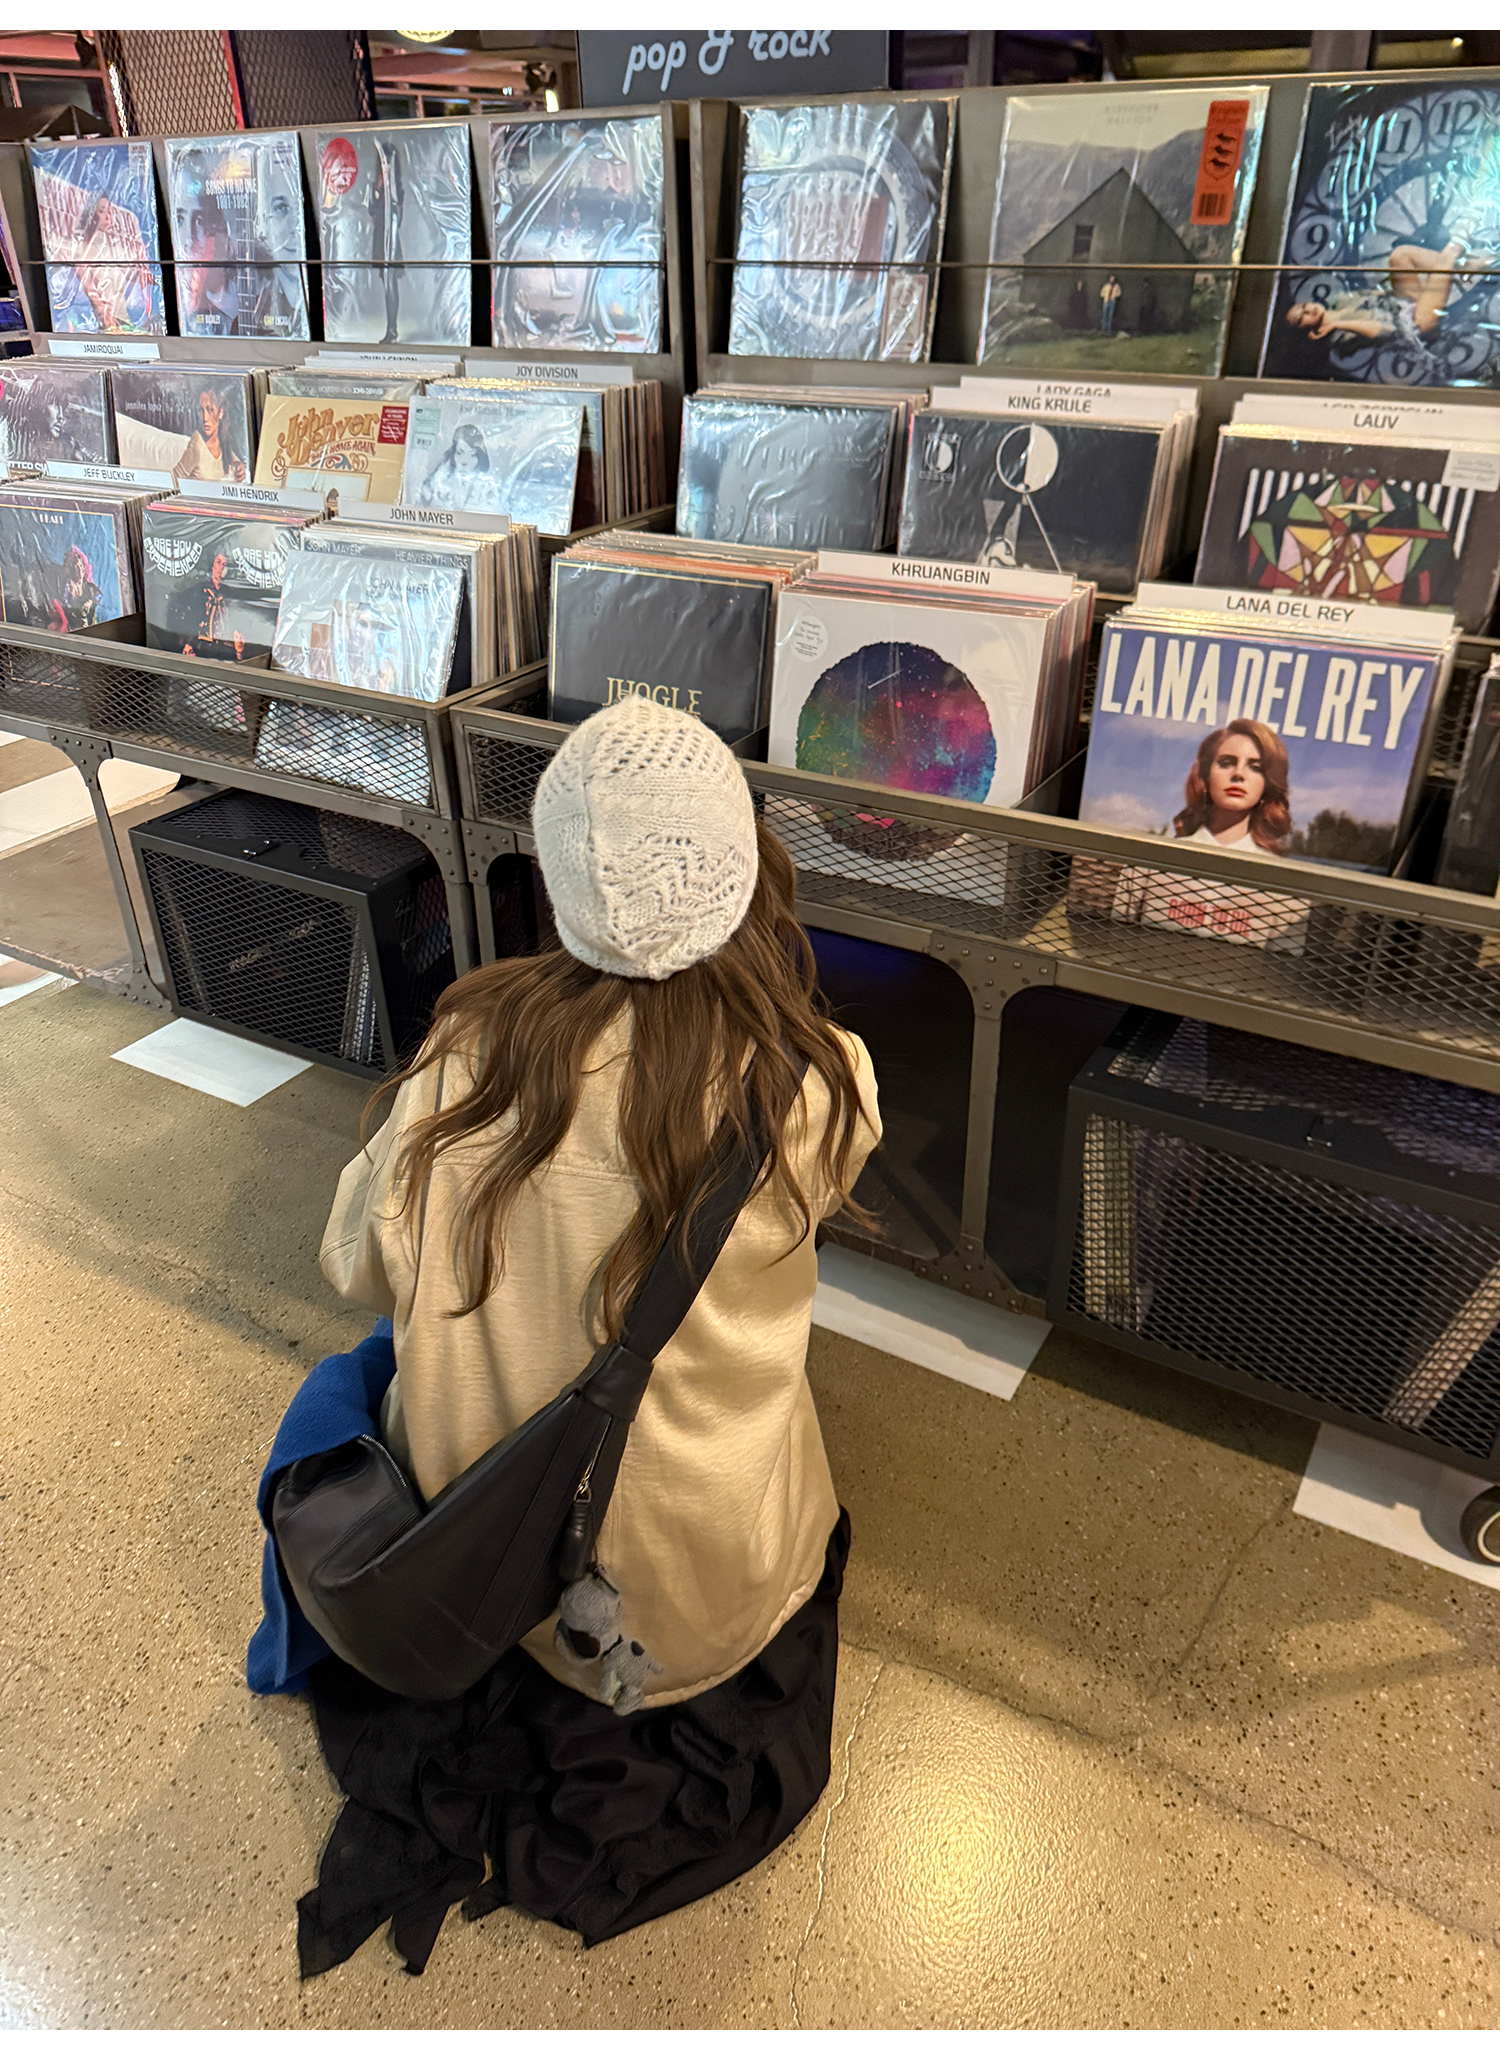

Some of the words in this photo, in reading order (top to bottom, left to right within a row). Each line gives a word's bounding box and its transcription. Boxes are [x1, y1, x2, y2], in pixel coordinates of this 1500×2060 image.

[622, 40, 687, 95] pop
[699, 30, 734, 75] &
[748, 30, 832, 61] rock
[1436, 101, 1482, 136] 12
[1302, 224, 1329, 260] 9
[83, 344, 124, 355] JAMIROQUAI
[515, 365, 534, 377] JOY
[535, 366, 579, 380] DIVISION
[1008, 395, 1042, 410] KING
[1044, 397, 1093, 413] KRULE
[1353, 413, 1400, 430] LAUV
[83, 467, 101, 479] JEFF
[101, 470, 135, 482] BUCKLEY
[221, 486, 239, 497] JIMI
[240, 488, 279, 502] HENDRIX
[389, 508, 416, 522] JOHN
[418, 511, 454, 525] MAYER
[154, 537, 172, 558] ARE
[173, 540, 192, 560] YOU
[243, 548, 262, 570] ARE
[306, 541, 331, 553] JOHN
[332, 543, 362, 556] MAYER
[394, 550, 433, 565] HEAVIER
[435, 556, 469, 570] THINGS
[891, 562, 991, 585] KHRUANGBIN
[1226, 595, 1272, 615] LANA
[1277, 600, 1313, 619] DEL
[1317, 606, 1356, 623] REY
[1100, 632, 1221, 726] LANA
[1227, 646, 1310, 738] DEL
[1315, 657, 1425, 750] REY
